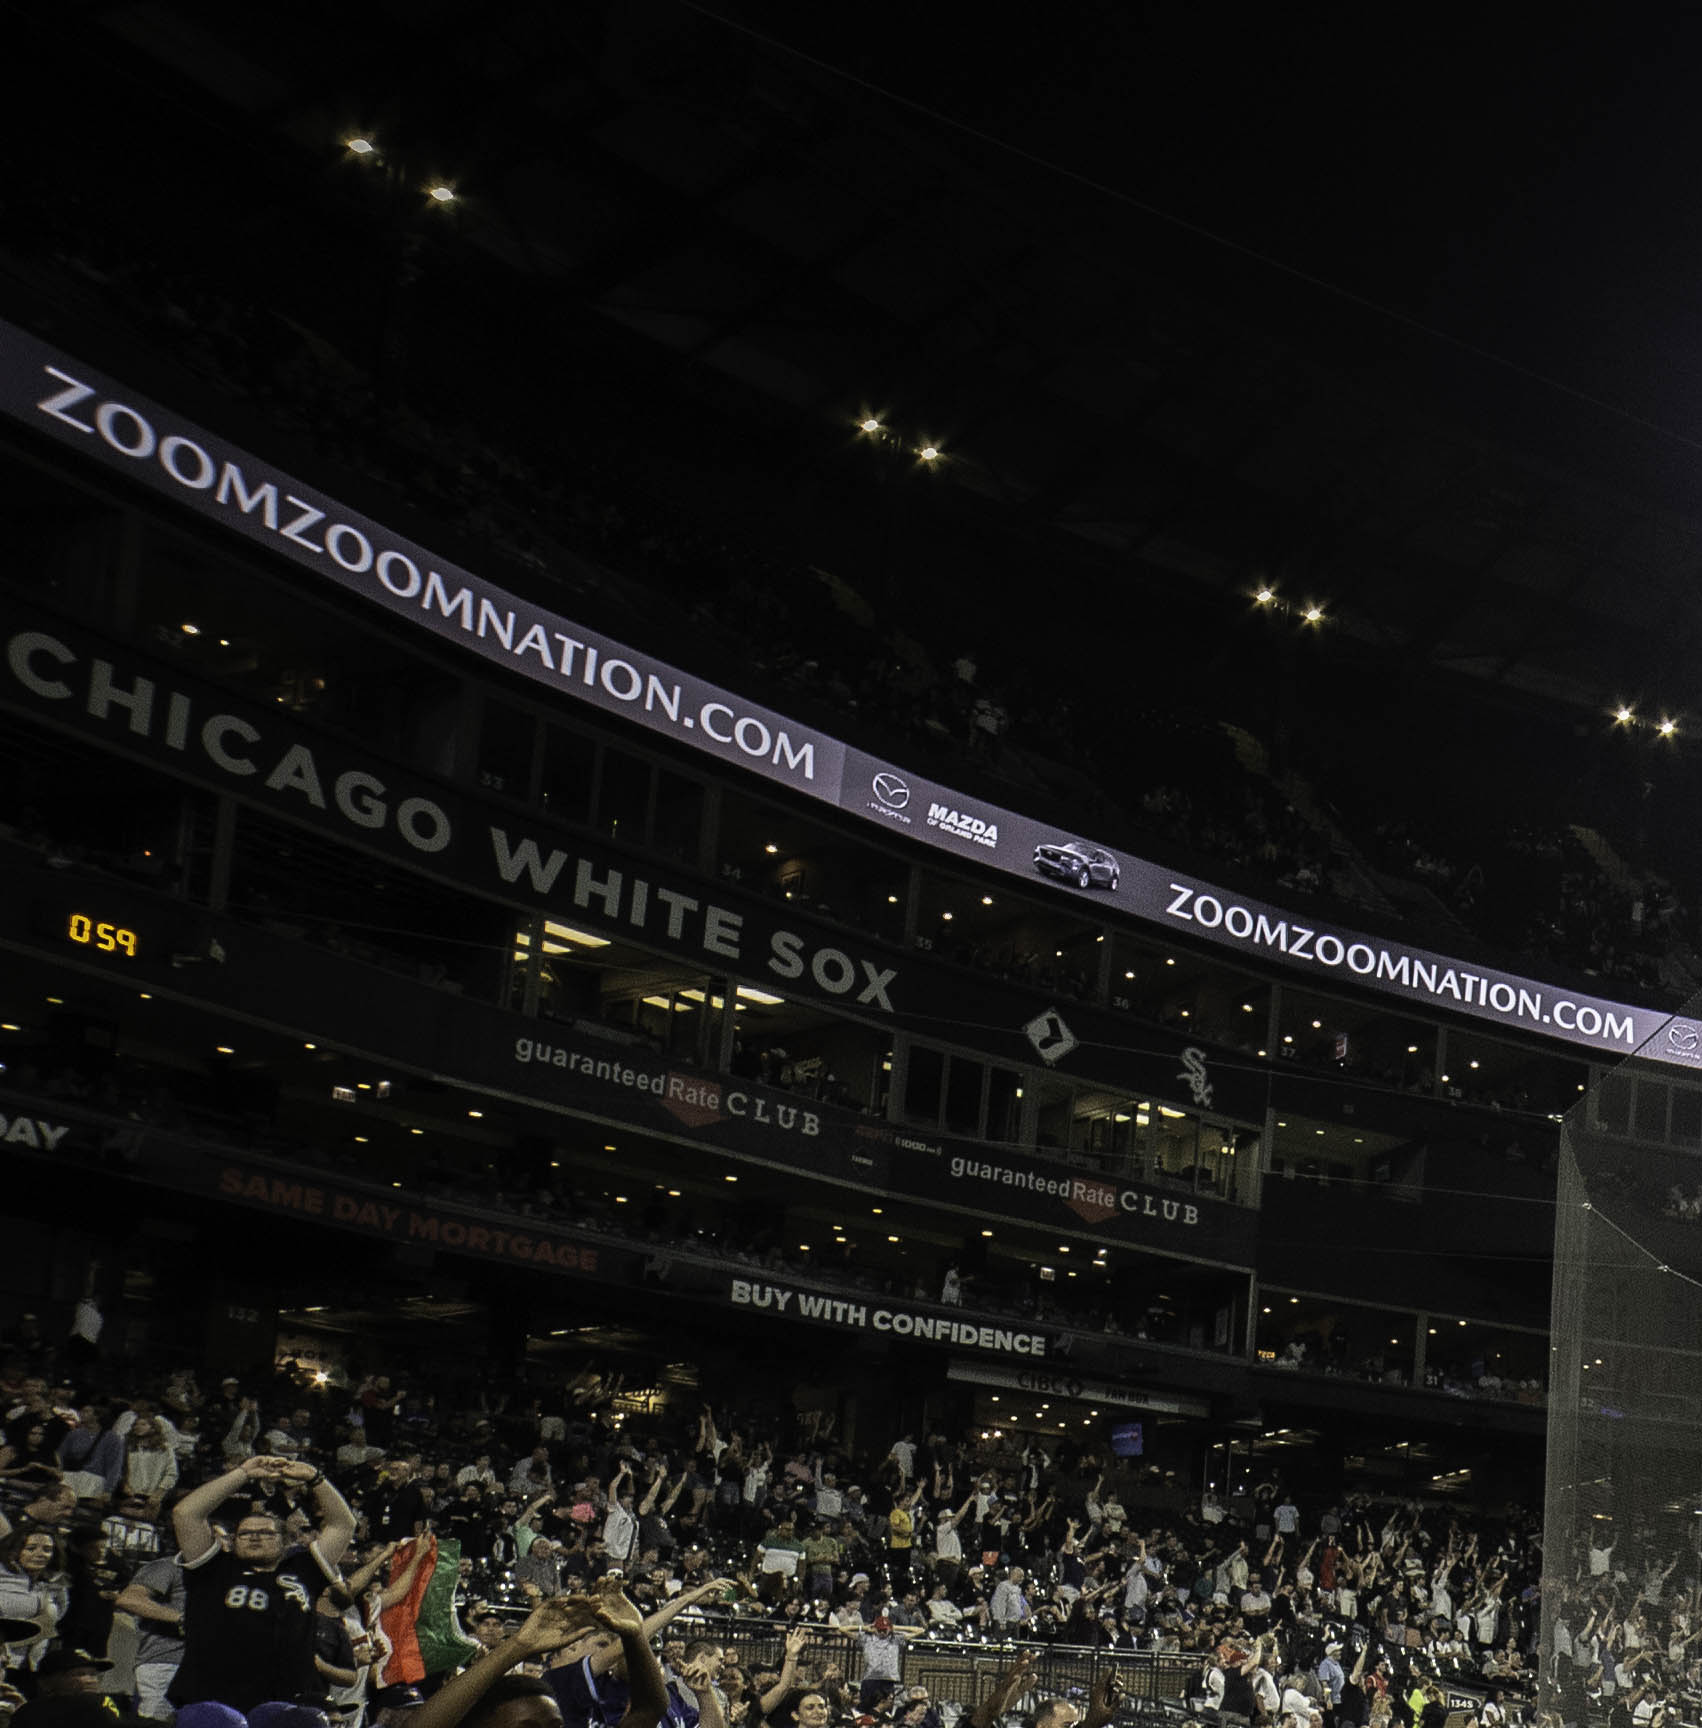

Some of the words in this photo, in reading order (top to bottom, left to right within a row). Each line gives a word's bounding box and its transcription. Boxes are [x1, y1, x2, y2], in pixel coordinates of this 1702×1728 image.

[37, 366, 816, 781] ZOOMZOOMNATION.COM
[8, 630, 453, 853] CHICAGO
[488, 827, 743, 960] WHITE
[768, 930, 897, 1014] SOX
[927, 803, 998, 841] MAZDA
[973, 833, 997, 848] PARK
[1166, 883, 1634, 1045] ZOOMZOOMNATION.COM
[515, 1037, 666, 1096] guaranteed
[668, 1077, 719, 1111] Rate
[727, 1091, 822, 1137] CLUB
[0, 1112, 70, 1153] AY
[219, 1168, 324, 1216] SAME
[334, 1196, 401, 1233] DAY
[408, 1213, 601, 1273] MORTGAGE
[951, 1156, 1072, 1198] guaranteed
[1073, 1181, 1116, 1208] Rate
[1121, 1191, 1201, 1226] CLUB
[731, 1278, 793, 1312] BUY
[798, 1293, 868, 1328] WITH
[872, 1309, 1046, 1357] CONFIDENCE
[1018, 1371, 1063, 1395] CIBC
[225, 1585, 269, 1610] 88
